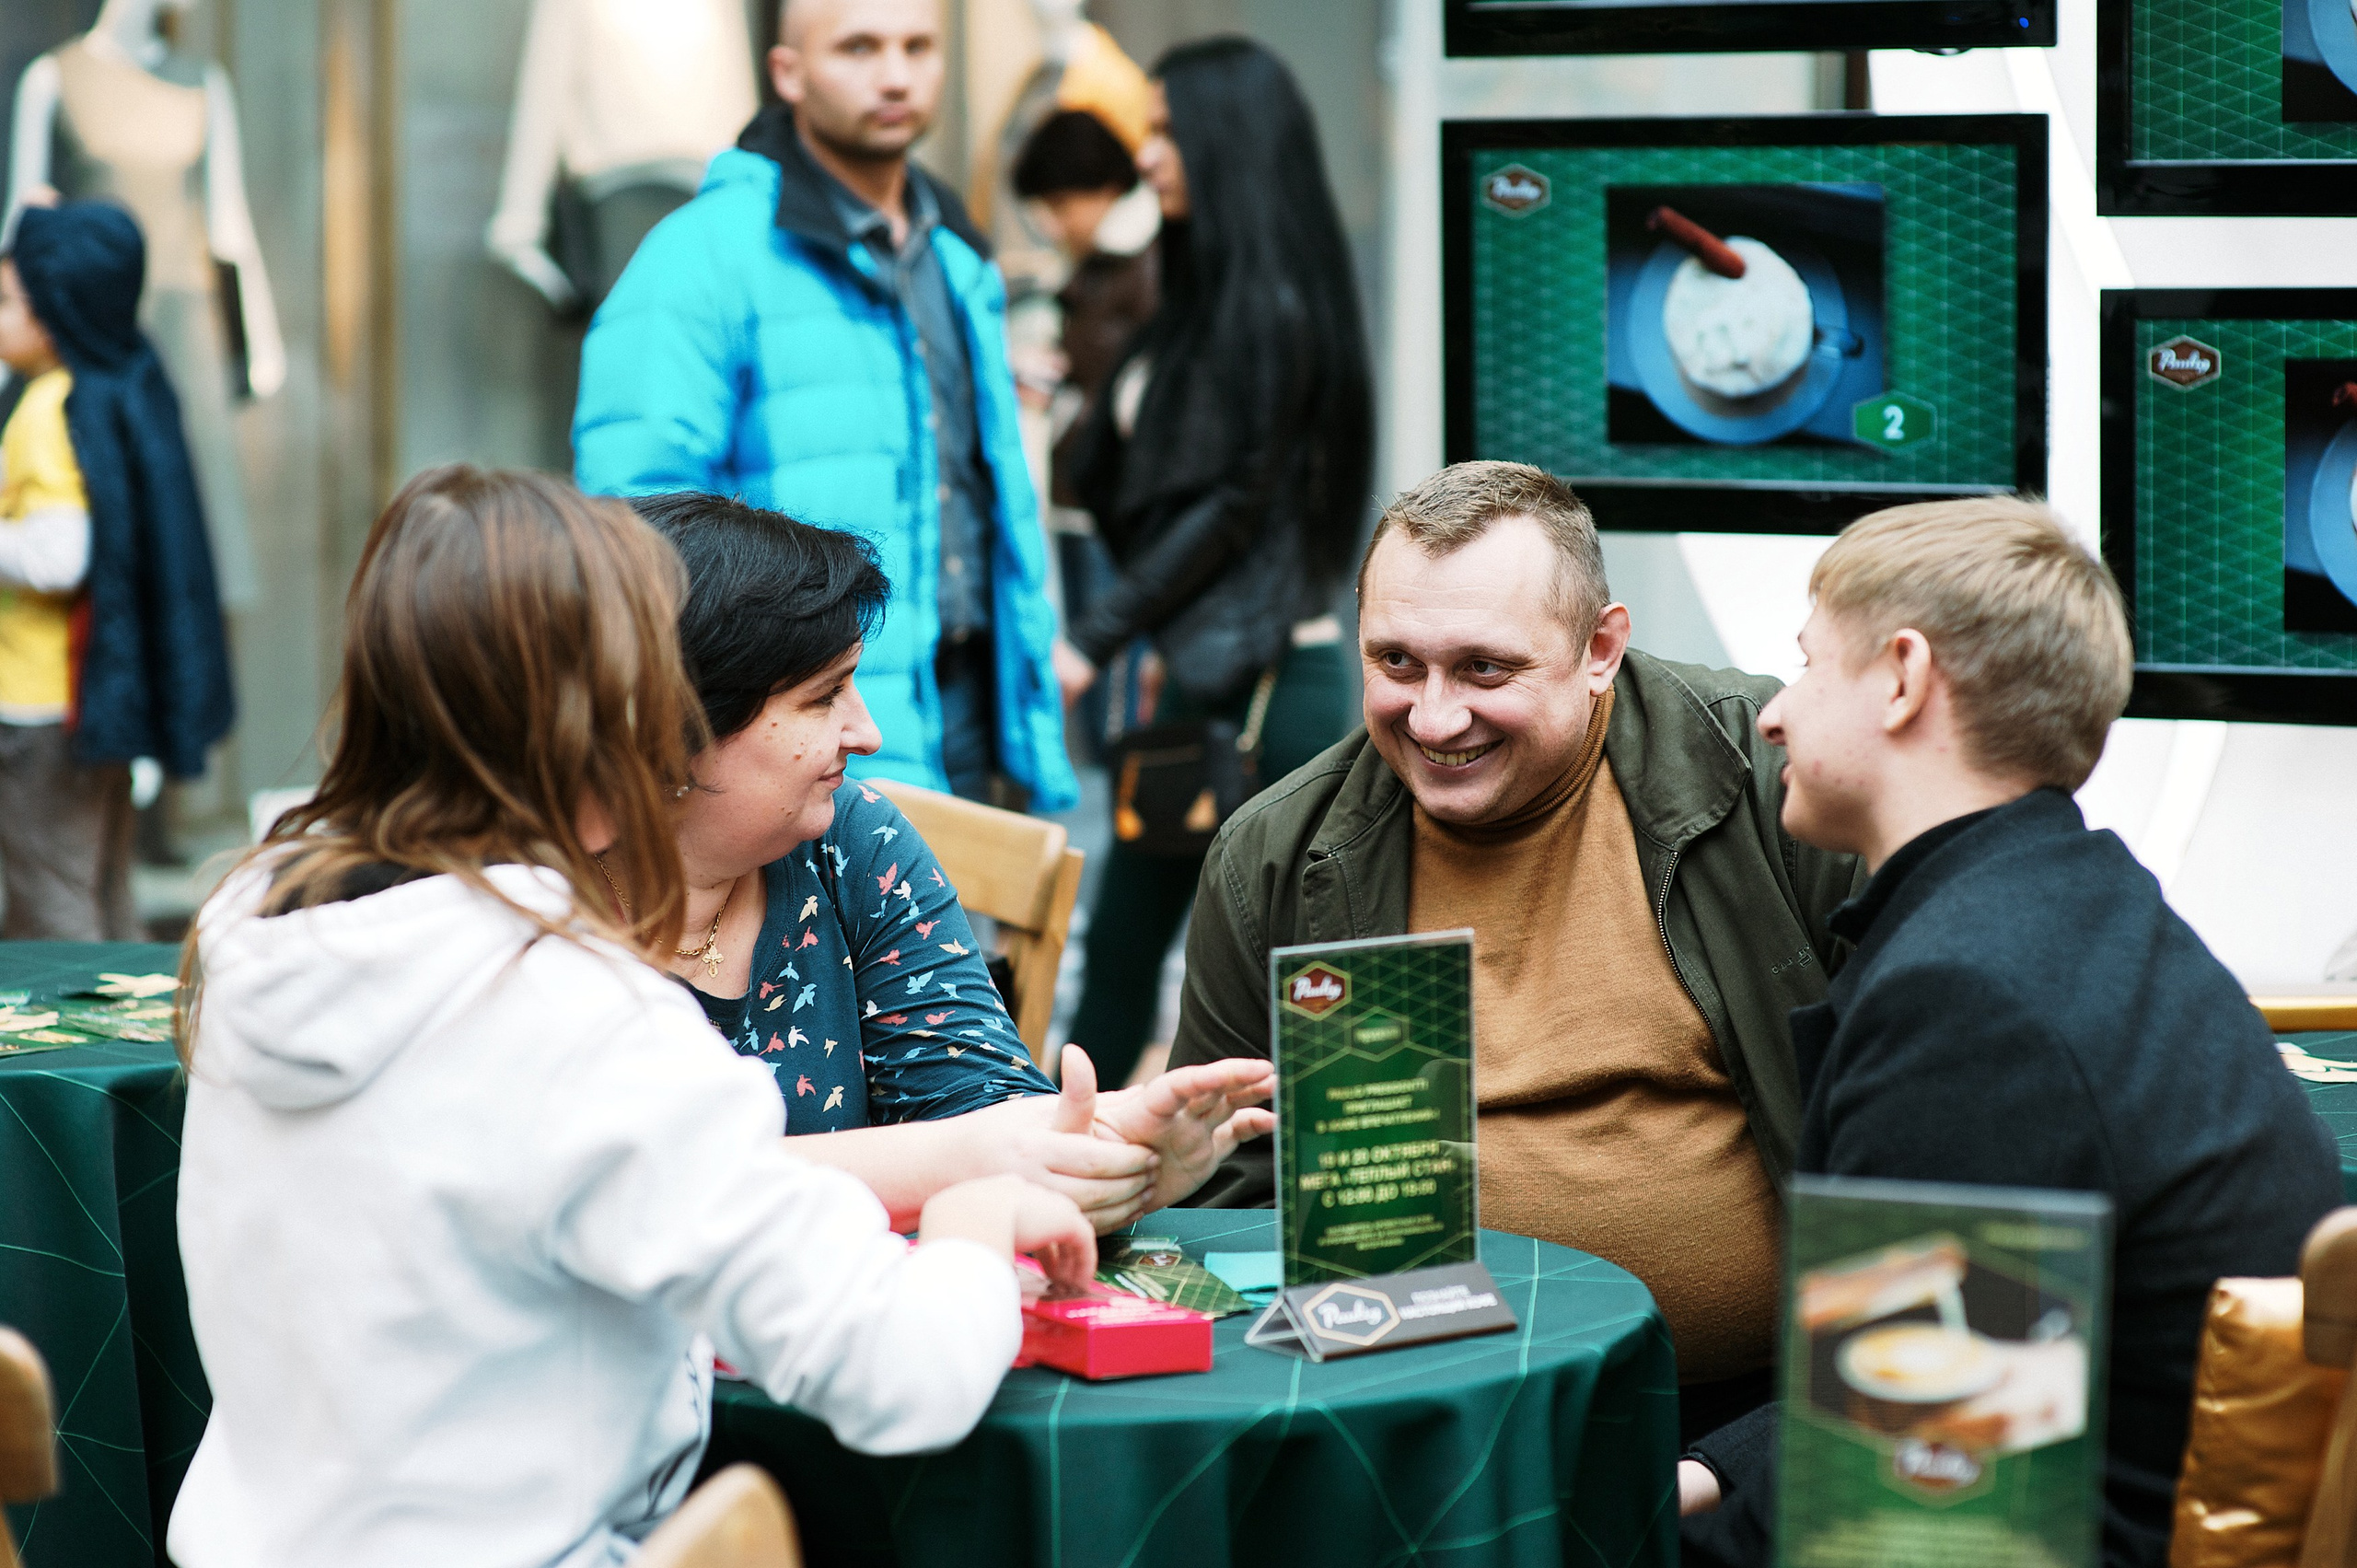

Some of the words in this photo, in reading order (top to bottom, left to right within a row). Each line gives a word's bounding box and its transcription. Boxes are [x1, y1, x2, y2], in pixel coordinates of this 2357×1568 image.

[1882, 404, 1905, 440] 2
[1370, 1139, 1440, 1163] ОКТЯБРЯ
[1298, 1169, 1341, 1191] МЕГА
[1374, 1181, 1399, 1204] ДО
